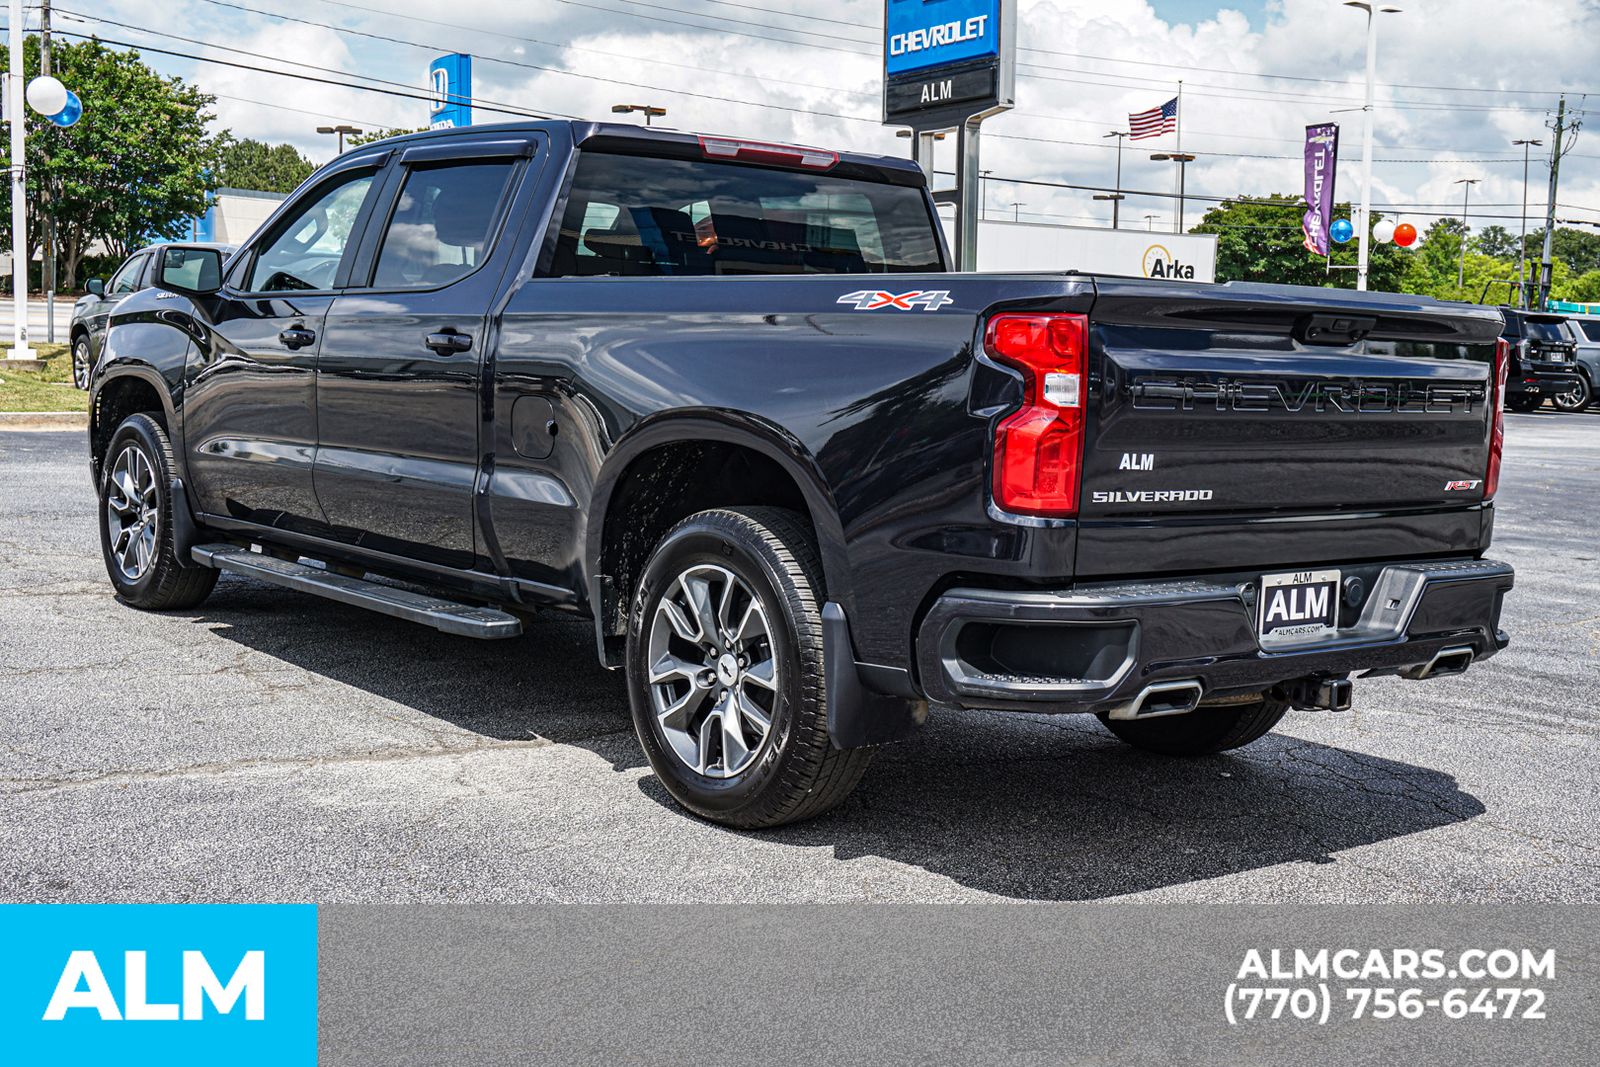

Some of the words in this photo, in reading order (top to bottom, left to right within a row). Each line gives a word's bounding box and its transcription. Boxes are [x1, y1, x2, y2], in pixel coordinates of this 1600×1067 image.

[890, 14, 988, 57] CHEVROLET
[920, 80, 952, 103] ALM
[1151, 258, 1195, 279] Arka
[1133, 375, 1484, 413] CHEVROLET
[1118, 453, 1154, 471] ALM
[1444, 479, 1482, 491] RST
[1092, 489, 1213, 503] SILVERADO
[1293, 572, 1312, 584] ALM
[1265, 586, 1329, 622] ALM
